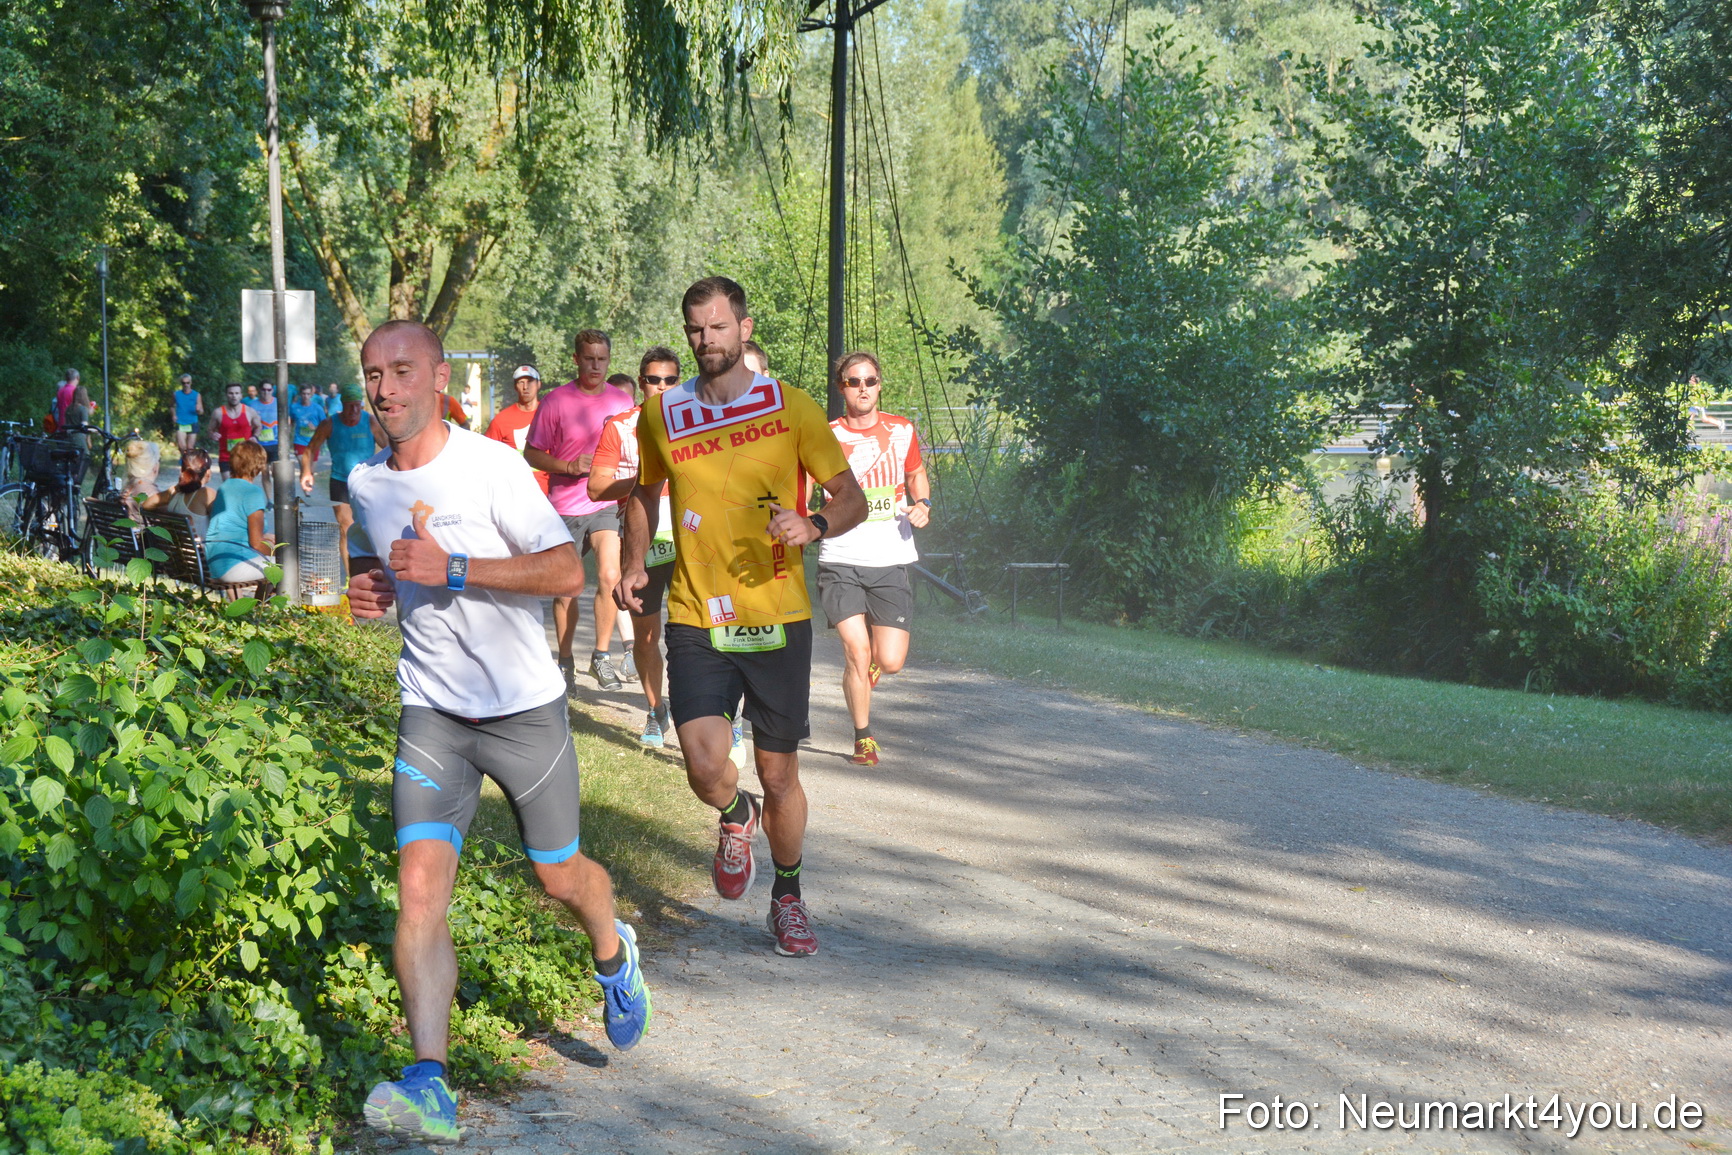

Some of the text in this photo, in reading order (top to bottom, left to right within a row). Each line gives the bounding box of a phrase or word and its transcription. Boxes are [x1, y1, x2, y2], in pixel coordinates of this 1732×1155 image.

[671, 418, 790, 465] MAX BÖGL
[431, 513, 462, 523] LANDKREIS
[432, 519, 462, 528] NEUMARKT
